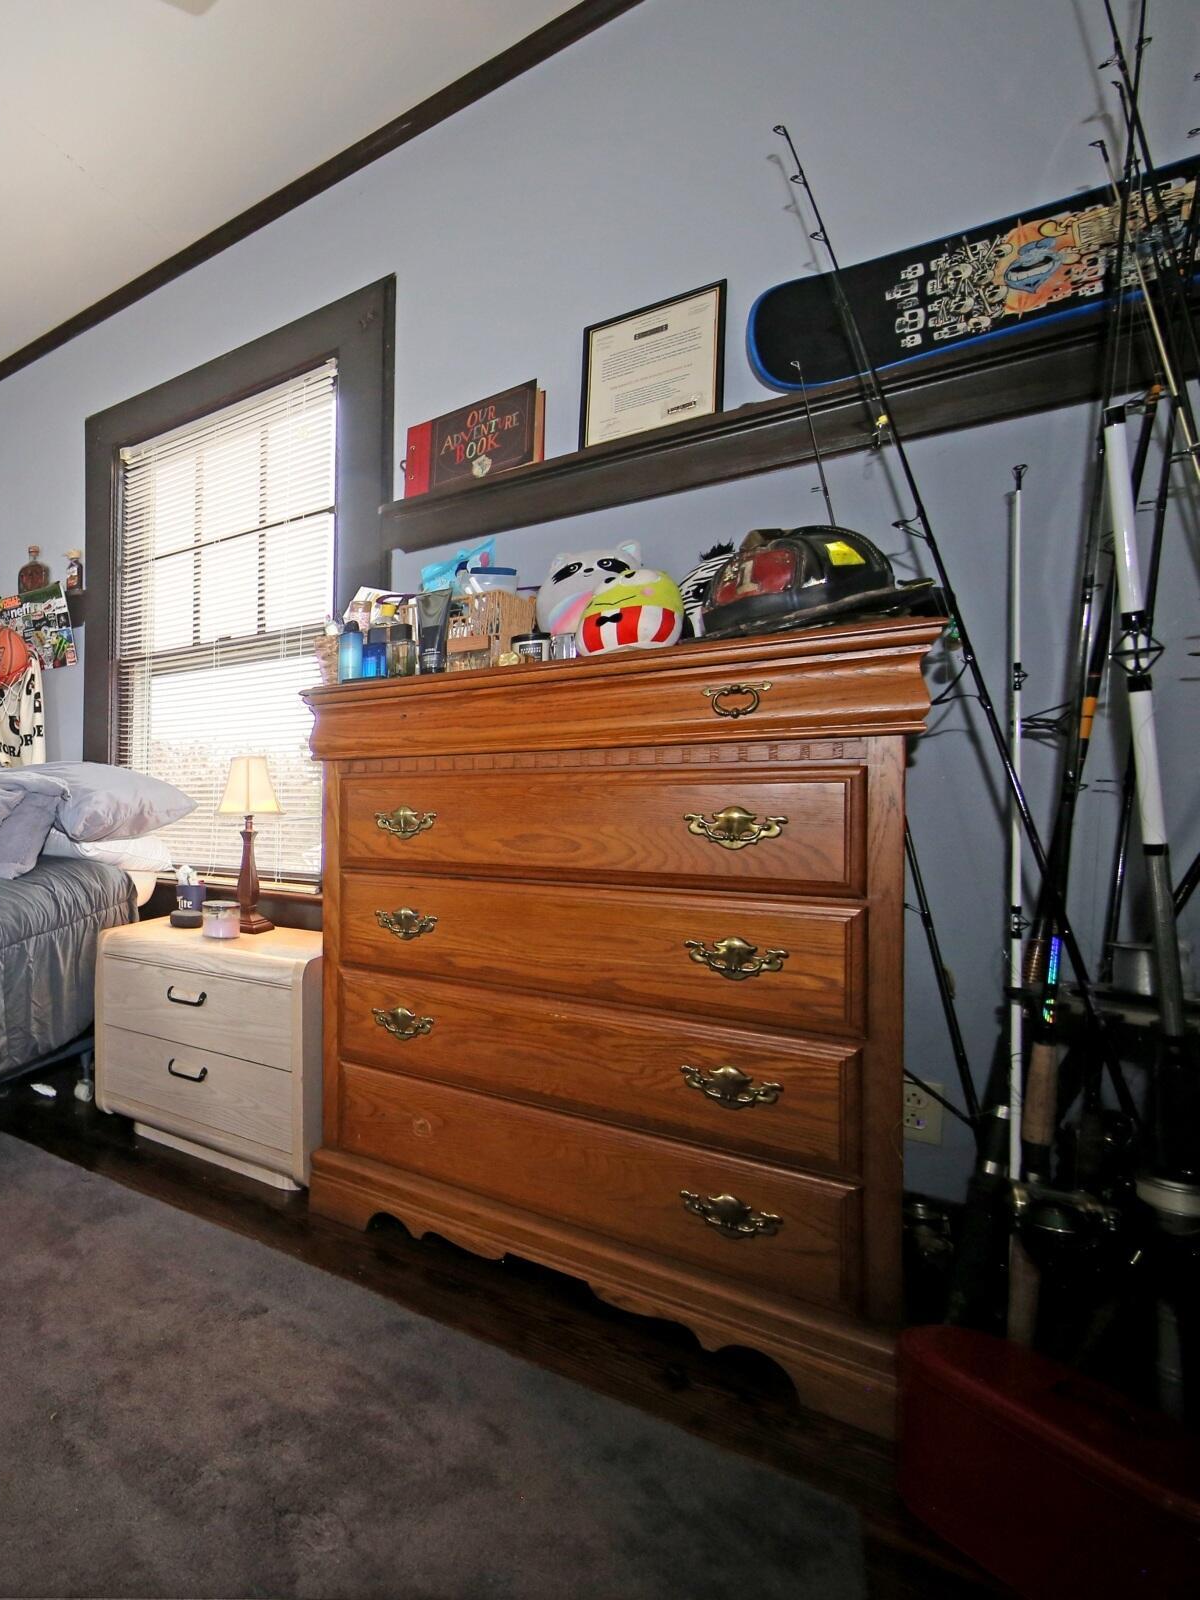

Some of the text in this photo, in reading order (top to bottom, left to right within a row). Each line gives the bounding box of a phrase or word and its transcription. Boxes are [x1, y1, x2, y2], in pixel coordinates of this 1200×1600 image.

[466, 405, 496, 429] OUR
[440, 411, 520, 456] ADVENTURE
[455, 434, 500, 465] BOOK
[10, 602, 31, 618] neff
[176, 896, 193, 910] Lite
